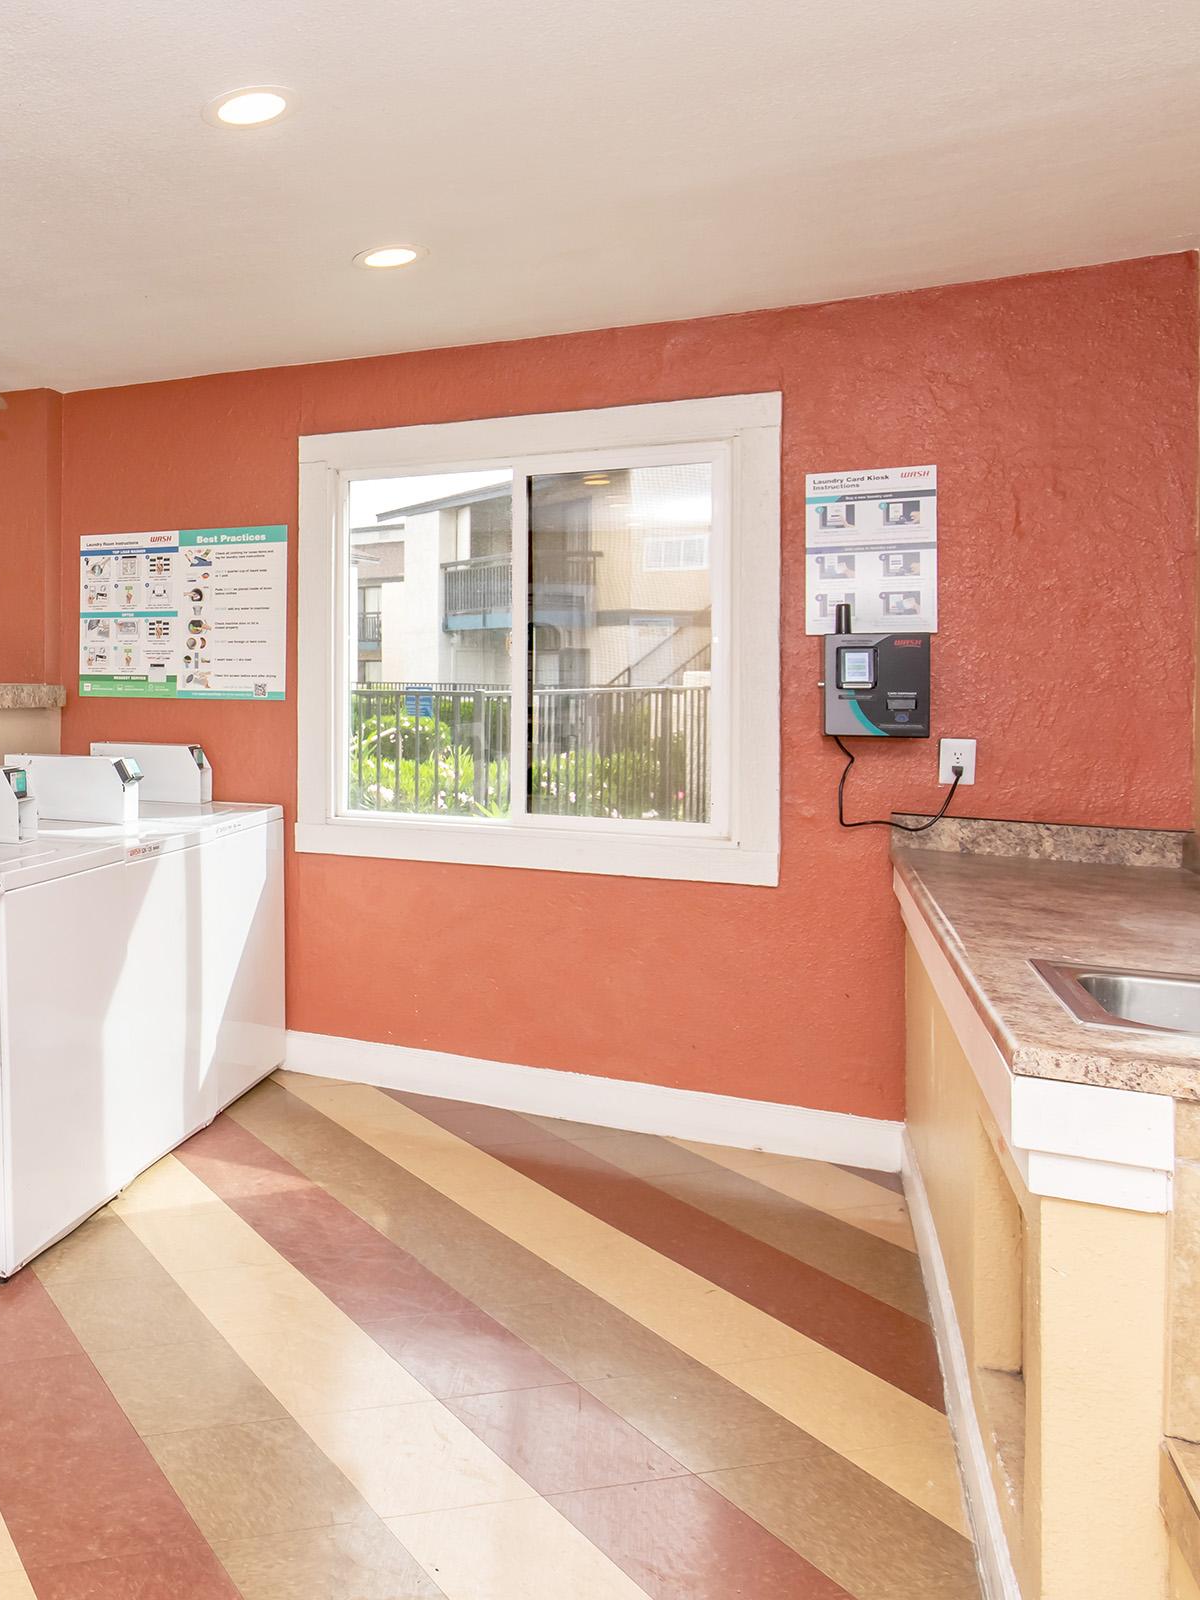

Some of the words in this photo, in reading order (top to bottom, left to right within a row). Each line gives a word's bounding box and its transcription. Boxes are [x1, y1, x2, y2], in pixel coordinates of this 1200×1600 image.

[900, 470, 930, 478] WASH
[812, 483, 860, 491] Instructions
[149, 535, 172, 543] WASH
[196, 535, 218, 544] Best
[220, 533, 266, 543] Practices
